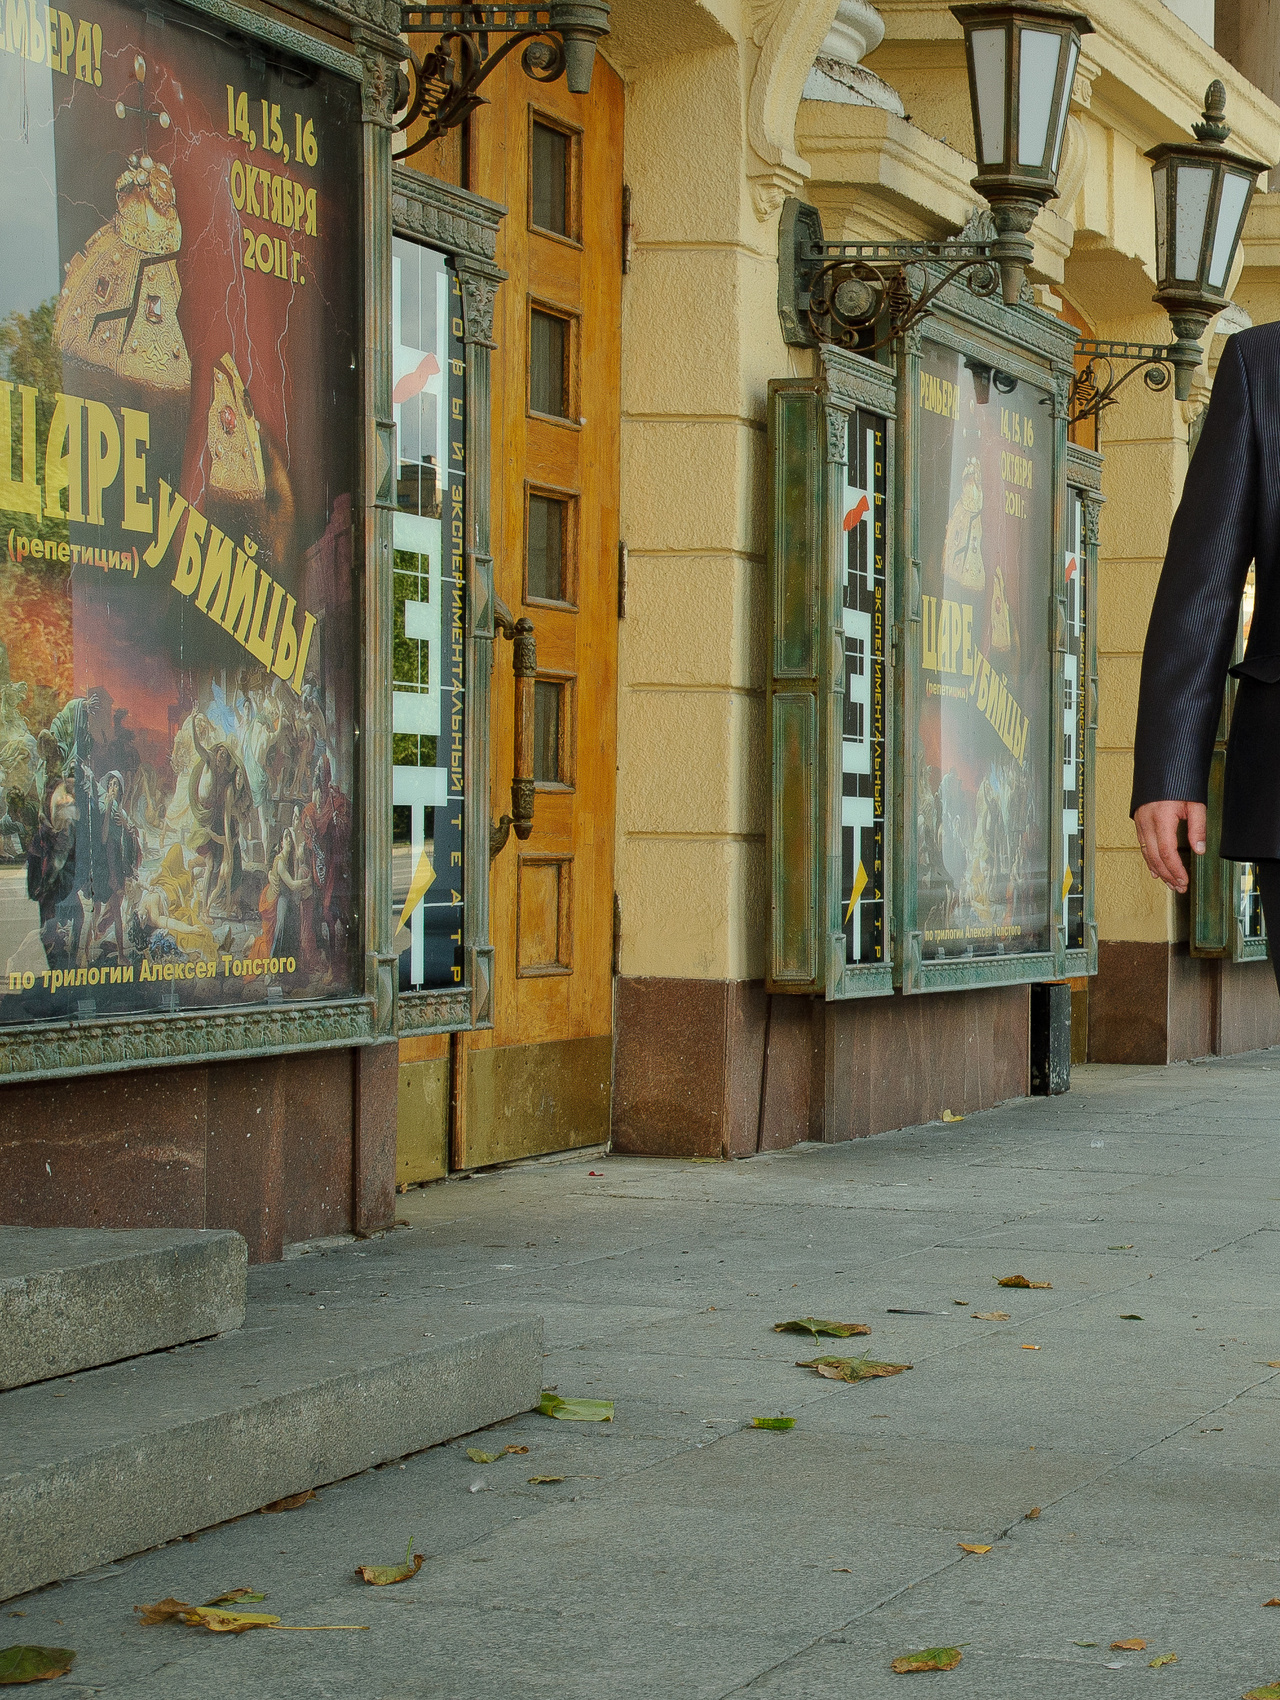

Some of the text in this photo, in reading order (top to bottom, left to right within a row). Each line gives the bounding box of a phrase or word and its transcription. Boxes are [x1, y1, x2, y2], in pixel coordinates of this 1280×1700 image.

[226, 84, 319, 168] 14, 15, 16
[229, 158, 319, 239] ОКТЯБРЯ
[243, 230, 307, 286] 2011 г.
[1000, 406, 1011, 444] 14,
[1023, 416, 1034, 448] 16
[1001, 450, 1033, 490] ОКТЯБРЯ
[1005, 491, 1020, 518] 2011
[8, 528, 141, 579] (репетиция)
[450, 277, 465, 982] НОВЫЙ ЭКСПЕРИМЕНТАЛЬНЫЙ ТЕАТР
[874, 585, 883, 816] ЭКСПЕРИМЕНТАЛЬНЫЙ
[926, 678, 969, 703] (репетиция)
[874, 832, 882, 958] ТЕАТР
[925, 923, 1021, 944] по трилогии Алексея Толстого
[9, 953, 296, 993] по трилогии Алексея Толстого
